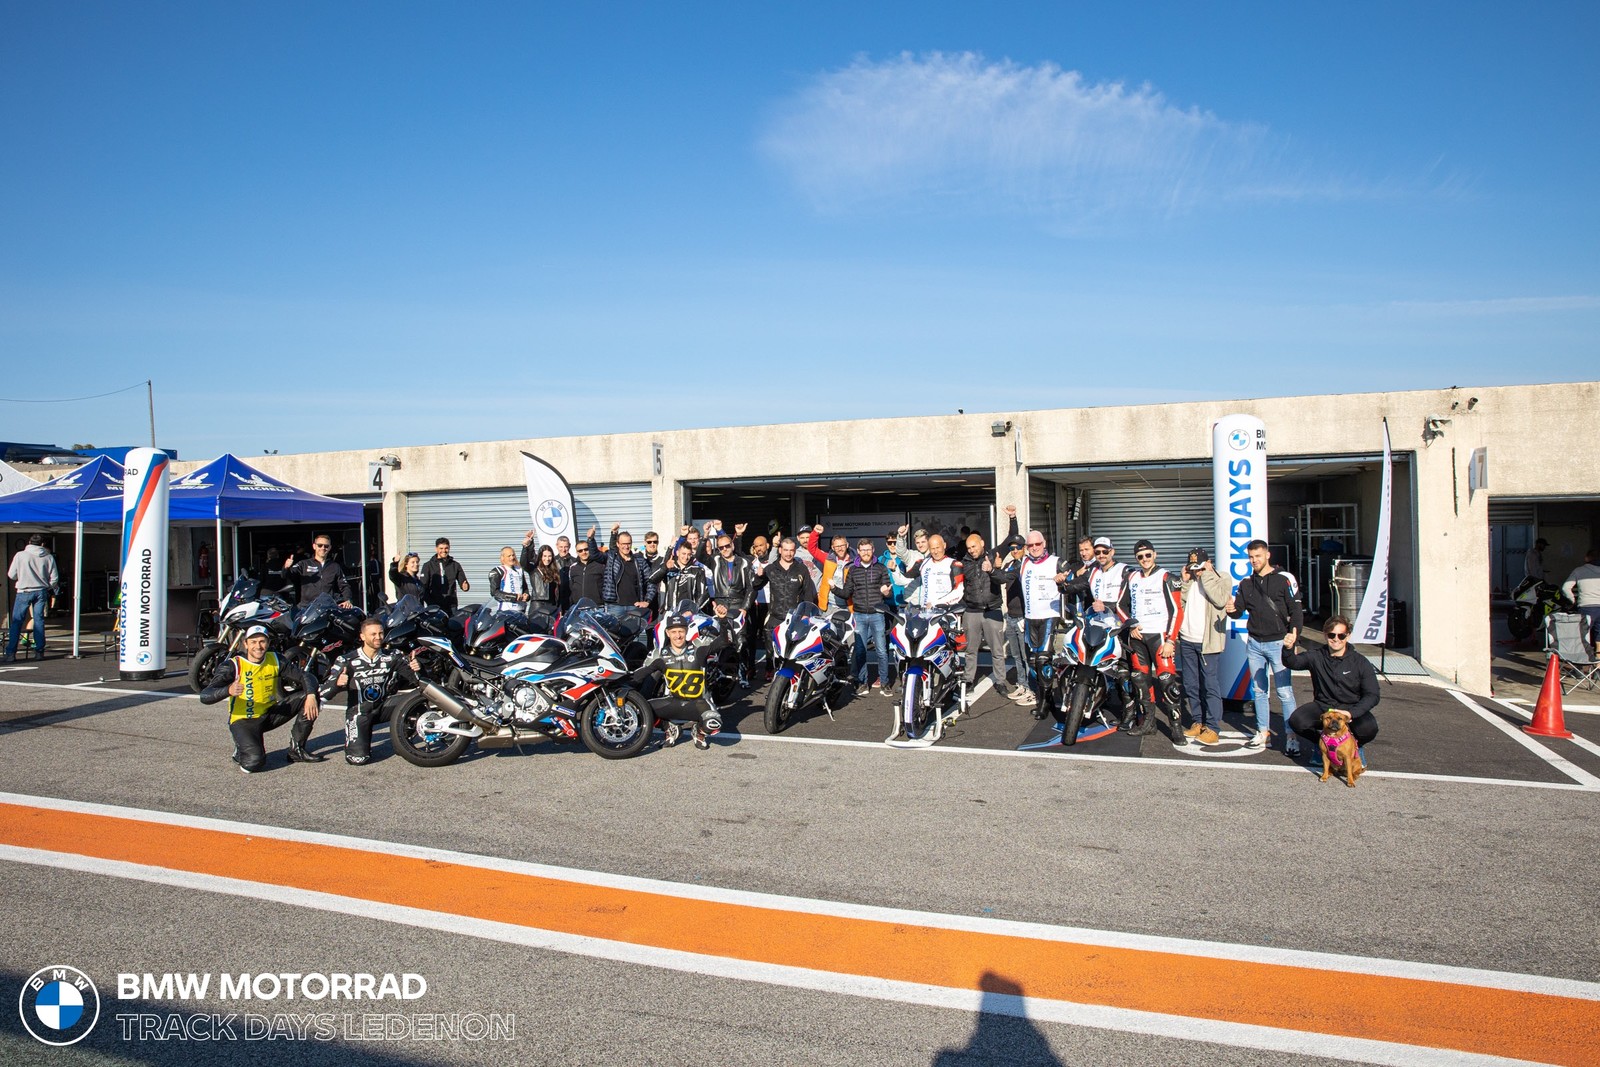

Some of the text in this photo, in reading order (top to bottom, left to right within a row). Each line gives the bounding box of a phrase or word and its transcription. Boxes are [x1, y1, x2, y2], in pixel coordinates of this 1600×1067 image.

[656, 448, 662, 475] 5
[238, 485, 295, 493] MICHELIN
[372, 467, 383, 491] 4
[1229, 459, 1252, 640] TCKDAYS
[139, 548, 152, 648] BMW MOTORRAD
[245, 670, 255, 719] RACKDAYS
[666, 668, 705, 698] 78
